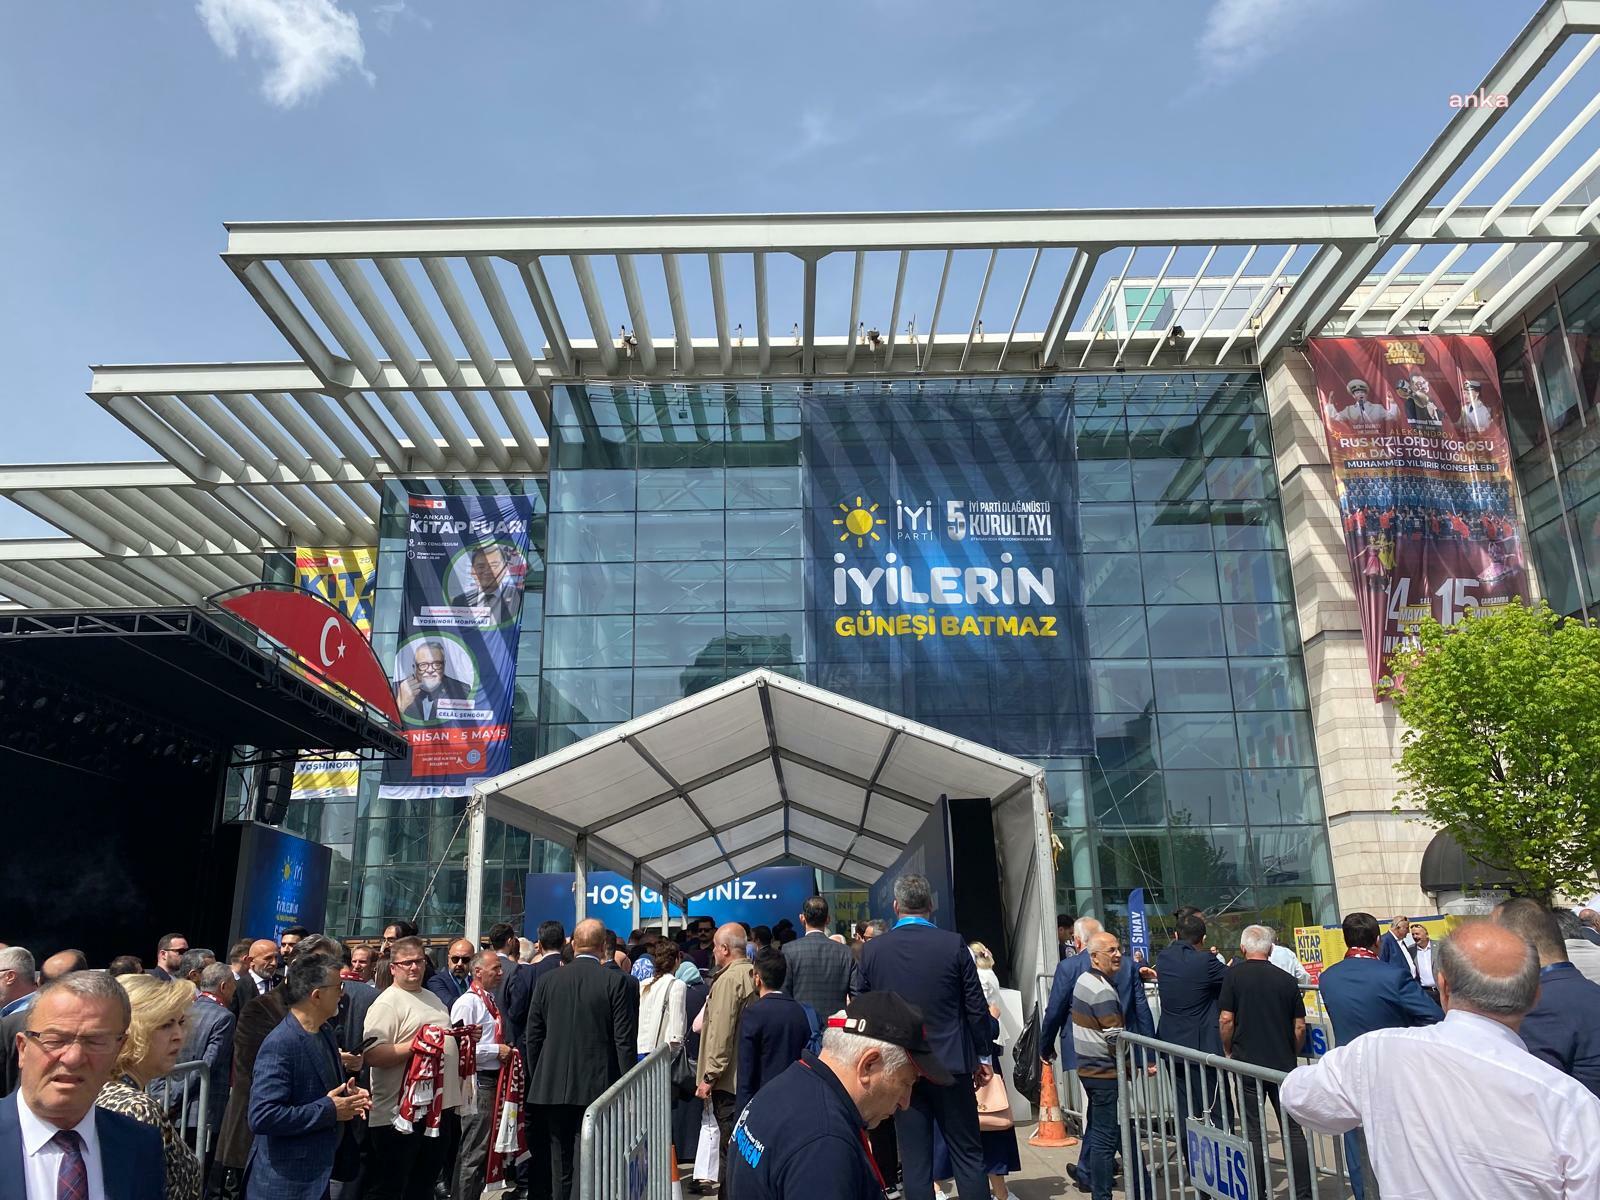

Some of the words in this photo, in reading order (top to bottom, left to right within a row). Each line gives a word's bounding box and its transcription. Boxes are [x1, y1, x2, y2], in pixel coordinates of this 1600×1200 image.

[1340, 437, 1369, 448] RUS
[1372, 436, 1439, 449] KIZILORDU
[1441, 439, 1494, 452] KOROSU
[1370, 448, 1404, 458] DANS
[1347, 460, 1405, 468] MUHAMMED
[896, 499, 932, 531] İYİ
[969, 500, 979, 513] İYİ
[980, 500, 1001, 513] PARTİ
[1002, 500, 1051, 513] OLAĞANÜSTÜ
[409, 518, 467, 534] KİTAP
[946, 500, 967, 541] 5
[970, 514, 1052, 536] KURULTAYI
[834, 552, 1056, 606] İYİLERİN
[1435, 577, 1480, 627] 15
[835, 607, 936, 641] GÜNEŞİ
[941, 616, 1058, 637] BATMAZ
[412, 731, 450, 743] NİSAN
[461, 731, 468, 740] 5
[472, 728, 507, 740] MAYIS
[1131, 911, 1143, 943] SINAV
[1300, 949, 1323, 963] FUARI
